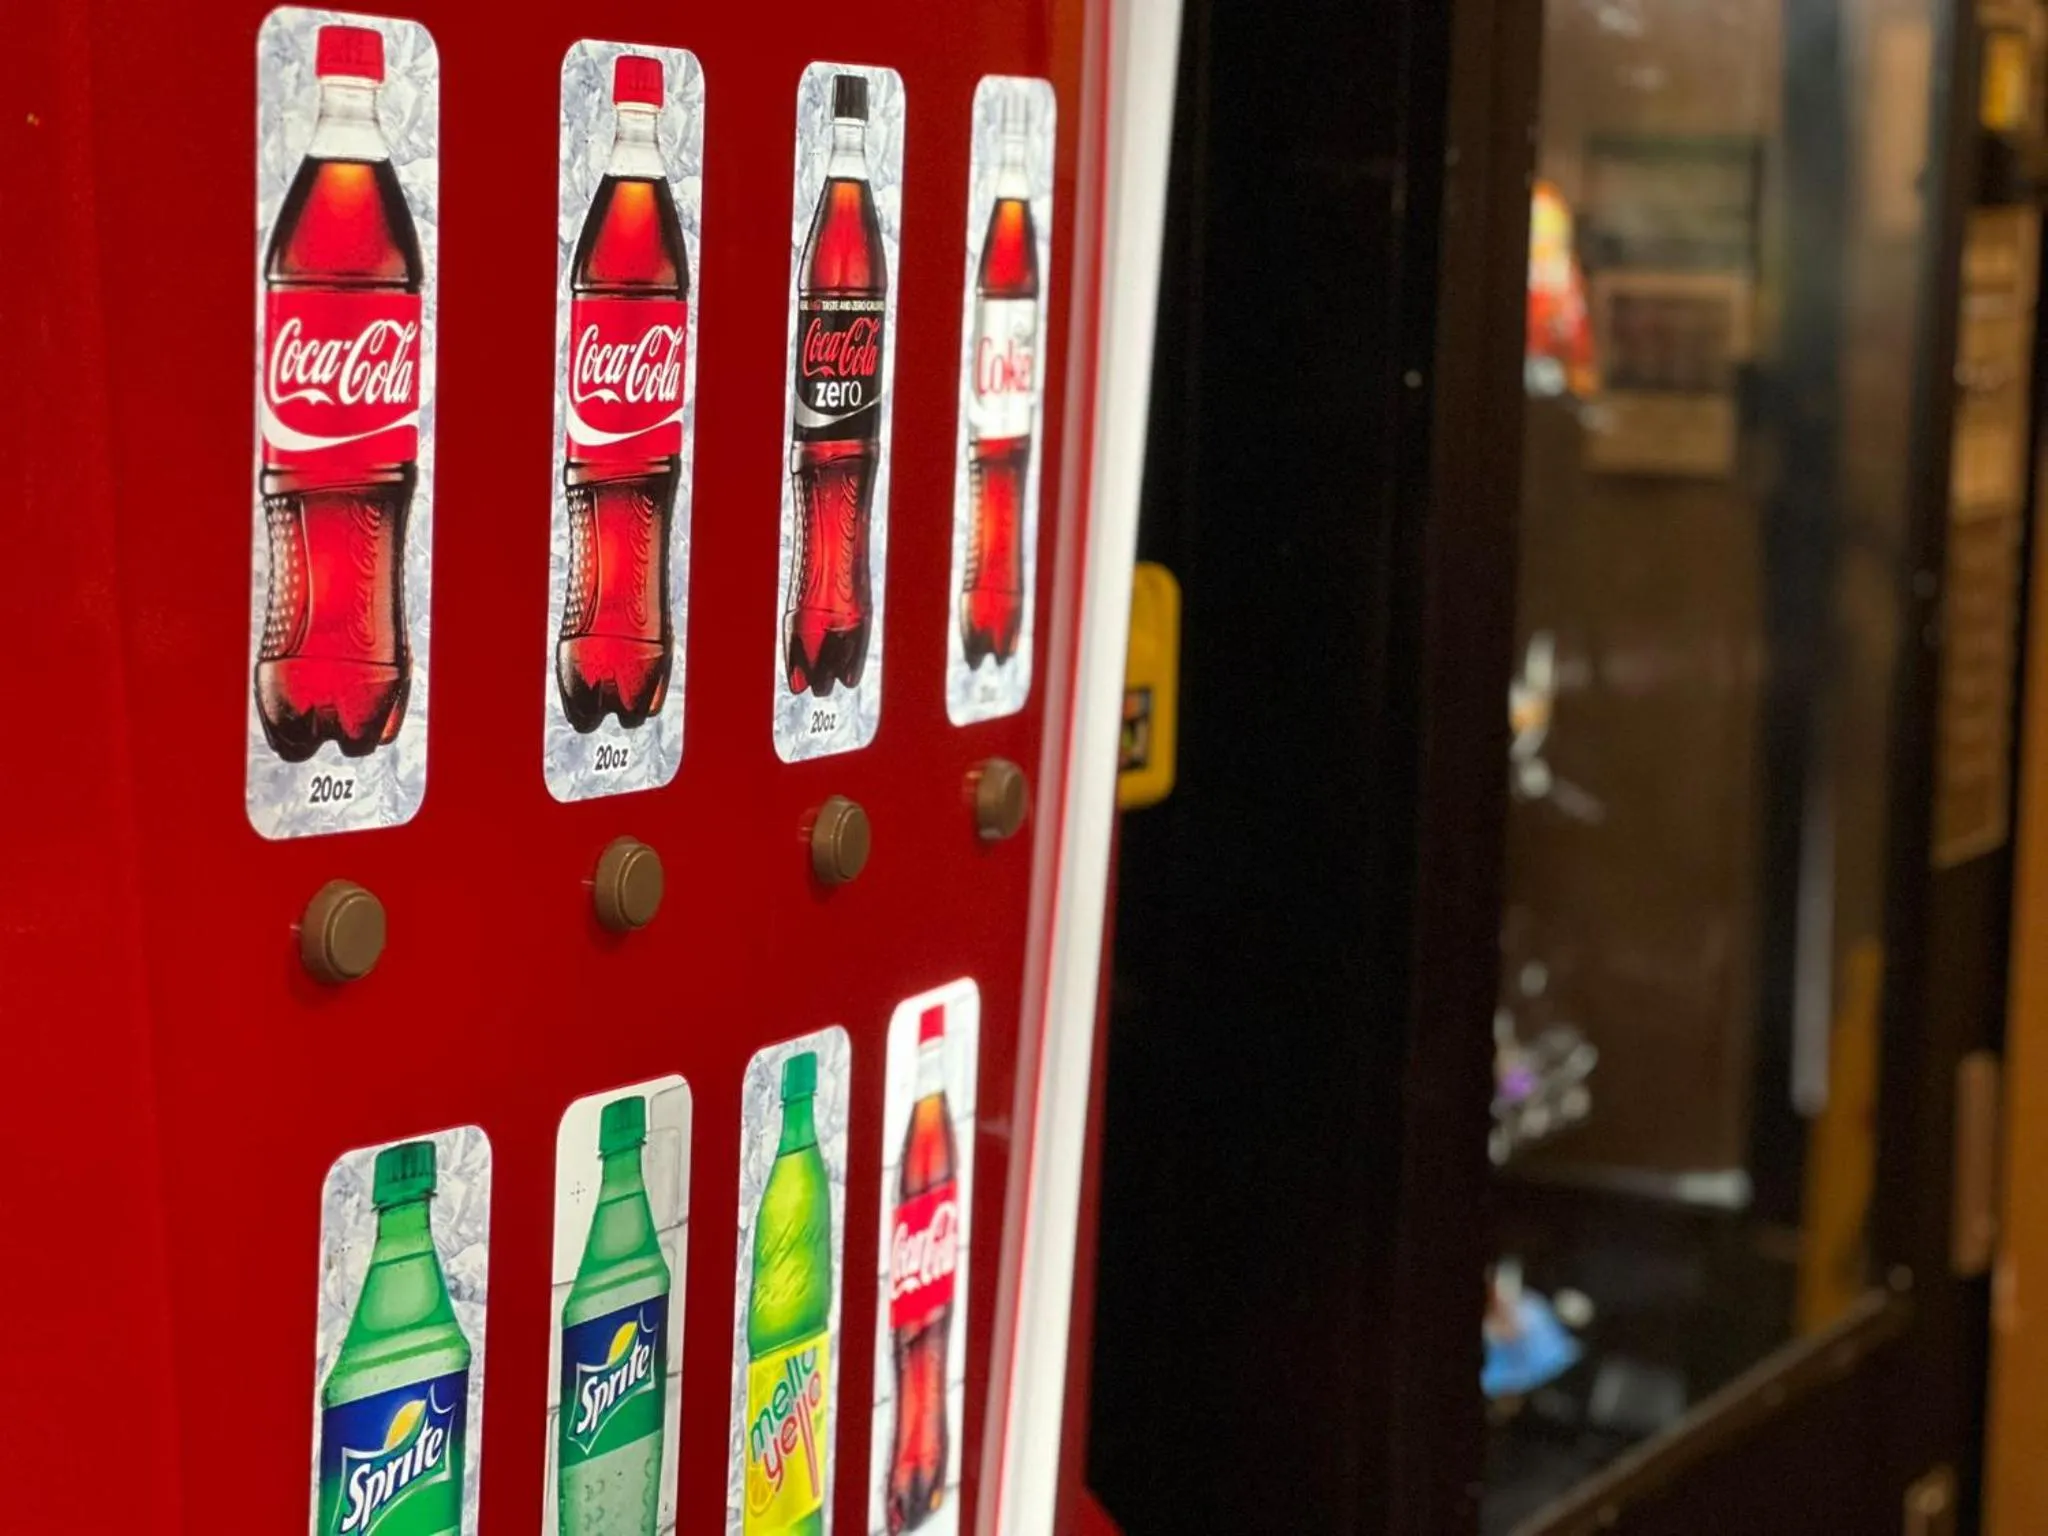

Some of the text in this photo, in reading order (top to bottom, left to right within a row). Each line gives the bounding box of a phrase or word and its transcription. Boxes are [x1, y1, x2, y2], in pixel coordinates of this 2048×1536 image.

[269, 317, 418, 405] Coca-Cola
[573, 323, 684, 404] Coca-Cola
[803, 317, 880, 377] Coca-Cola
[815, 380, 862, 407] zero
[594, 746, 628, 771] 20oz
[810, 710, 836, 733] 20oz
[309, 775, 354, 803] 20oz
[889, 1201, 957, 1300] Coca-Cola
[576, 1333, 650, 1434] Sprite
[750, 1345, 817, 1463] mello
[341, 1416, 444, 1533] Sprite
[763, 1371, 822, 1500] yello
